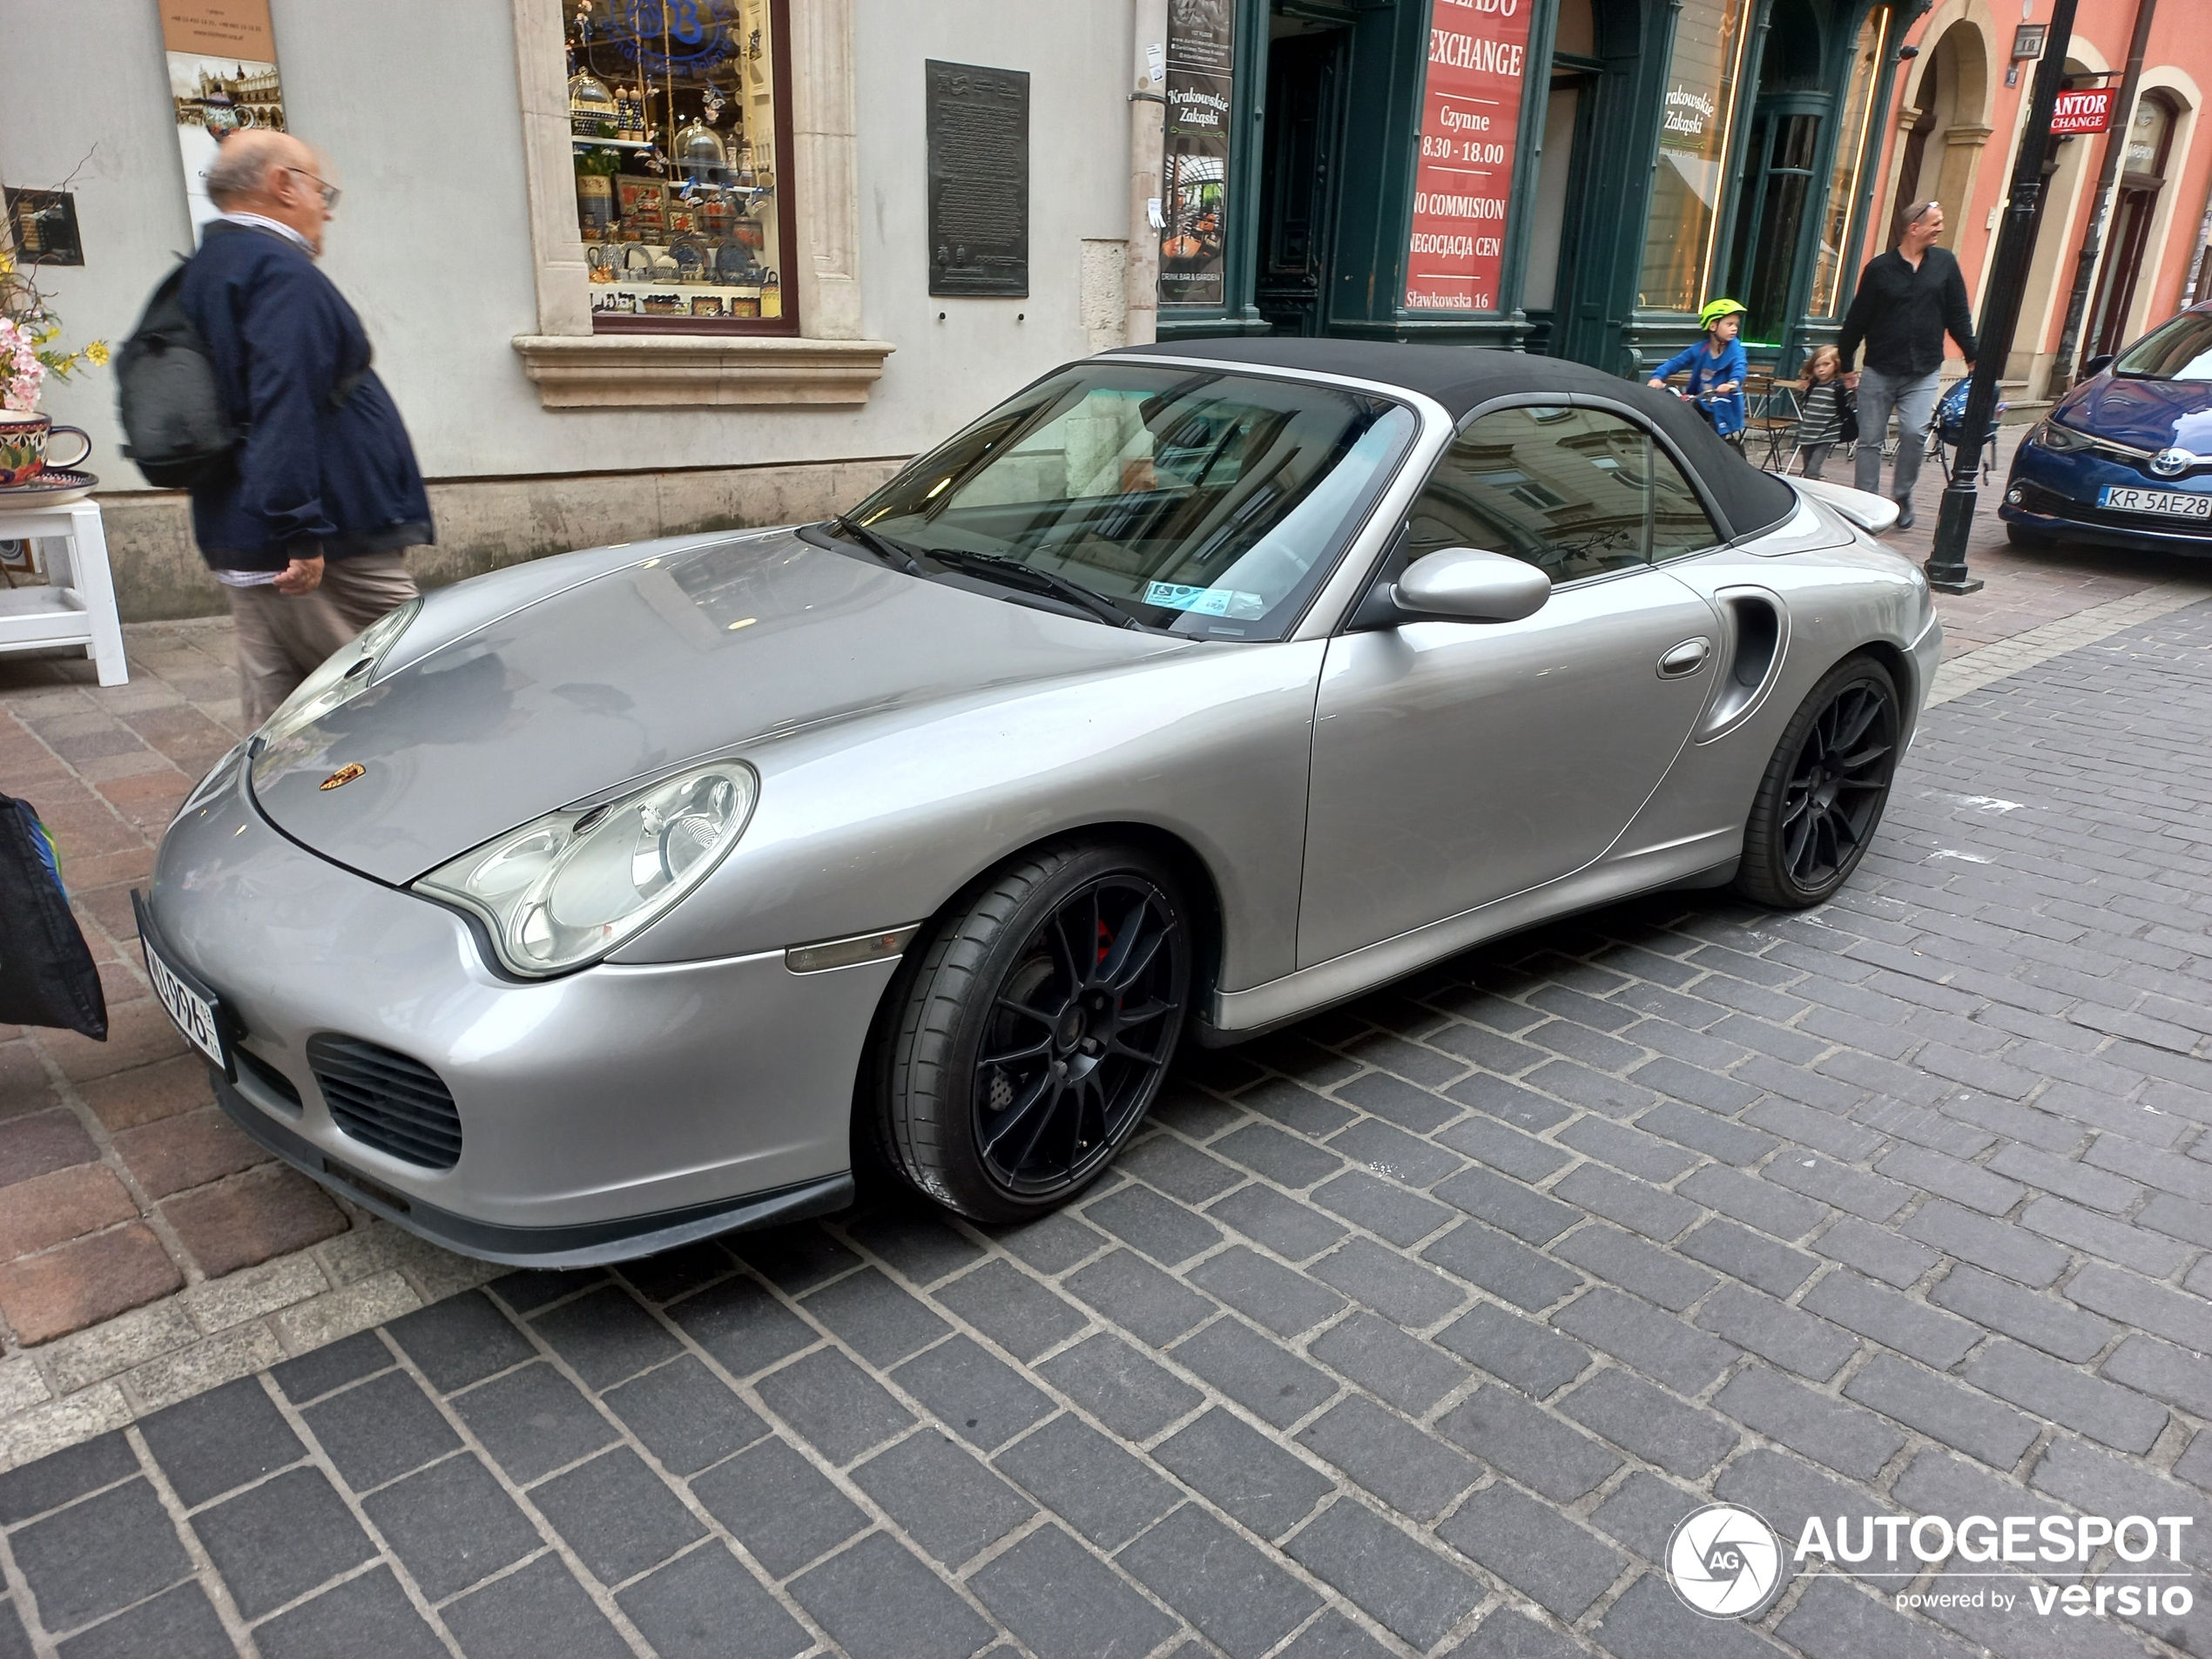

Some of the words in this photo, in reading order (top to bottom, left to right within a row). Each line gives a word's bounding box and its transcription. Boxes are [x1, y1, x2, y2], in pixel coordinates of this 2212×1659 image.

[1428, 29, 1523, 77] EXCHANGE
[2022, 39, 2035, 51] 18
[1167, 87, 1229, 111] Krakowskie
[1665, 84, 1714, 118] rakowskie
[2054, 95, 2107, 115] ANTOR
[1179, 107, 1219, 127] Zakąski
[1440, 105, 1490, 133] Czynne
[1664, 111, 1703, 137] Zakąski
[2051, 116, 2104, 129] CHANGE
[1422, 136, 1451, 158] 8.30
[1462, 141, 1504, 165] 18.00
[1429, 193, 1506, 219] COMMISION
[1476, 237, 1501, 257] CEN
[1406, 291, 1472, 308] Sławkowska
[1474, 293, 1488, 308] 16
[2108, 489, 2139, 508] KR
[2144, 493, 2209, 515] 5AE28
